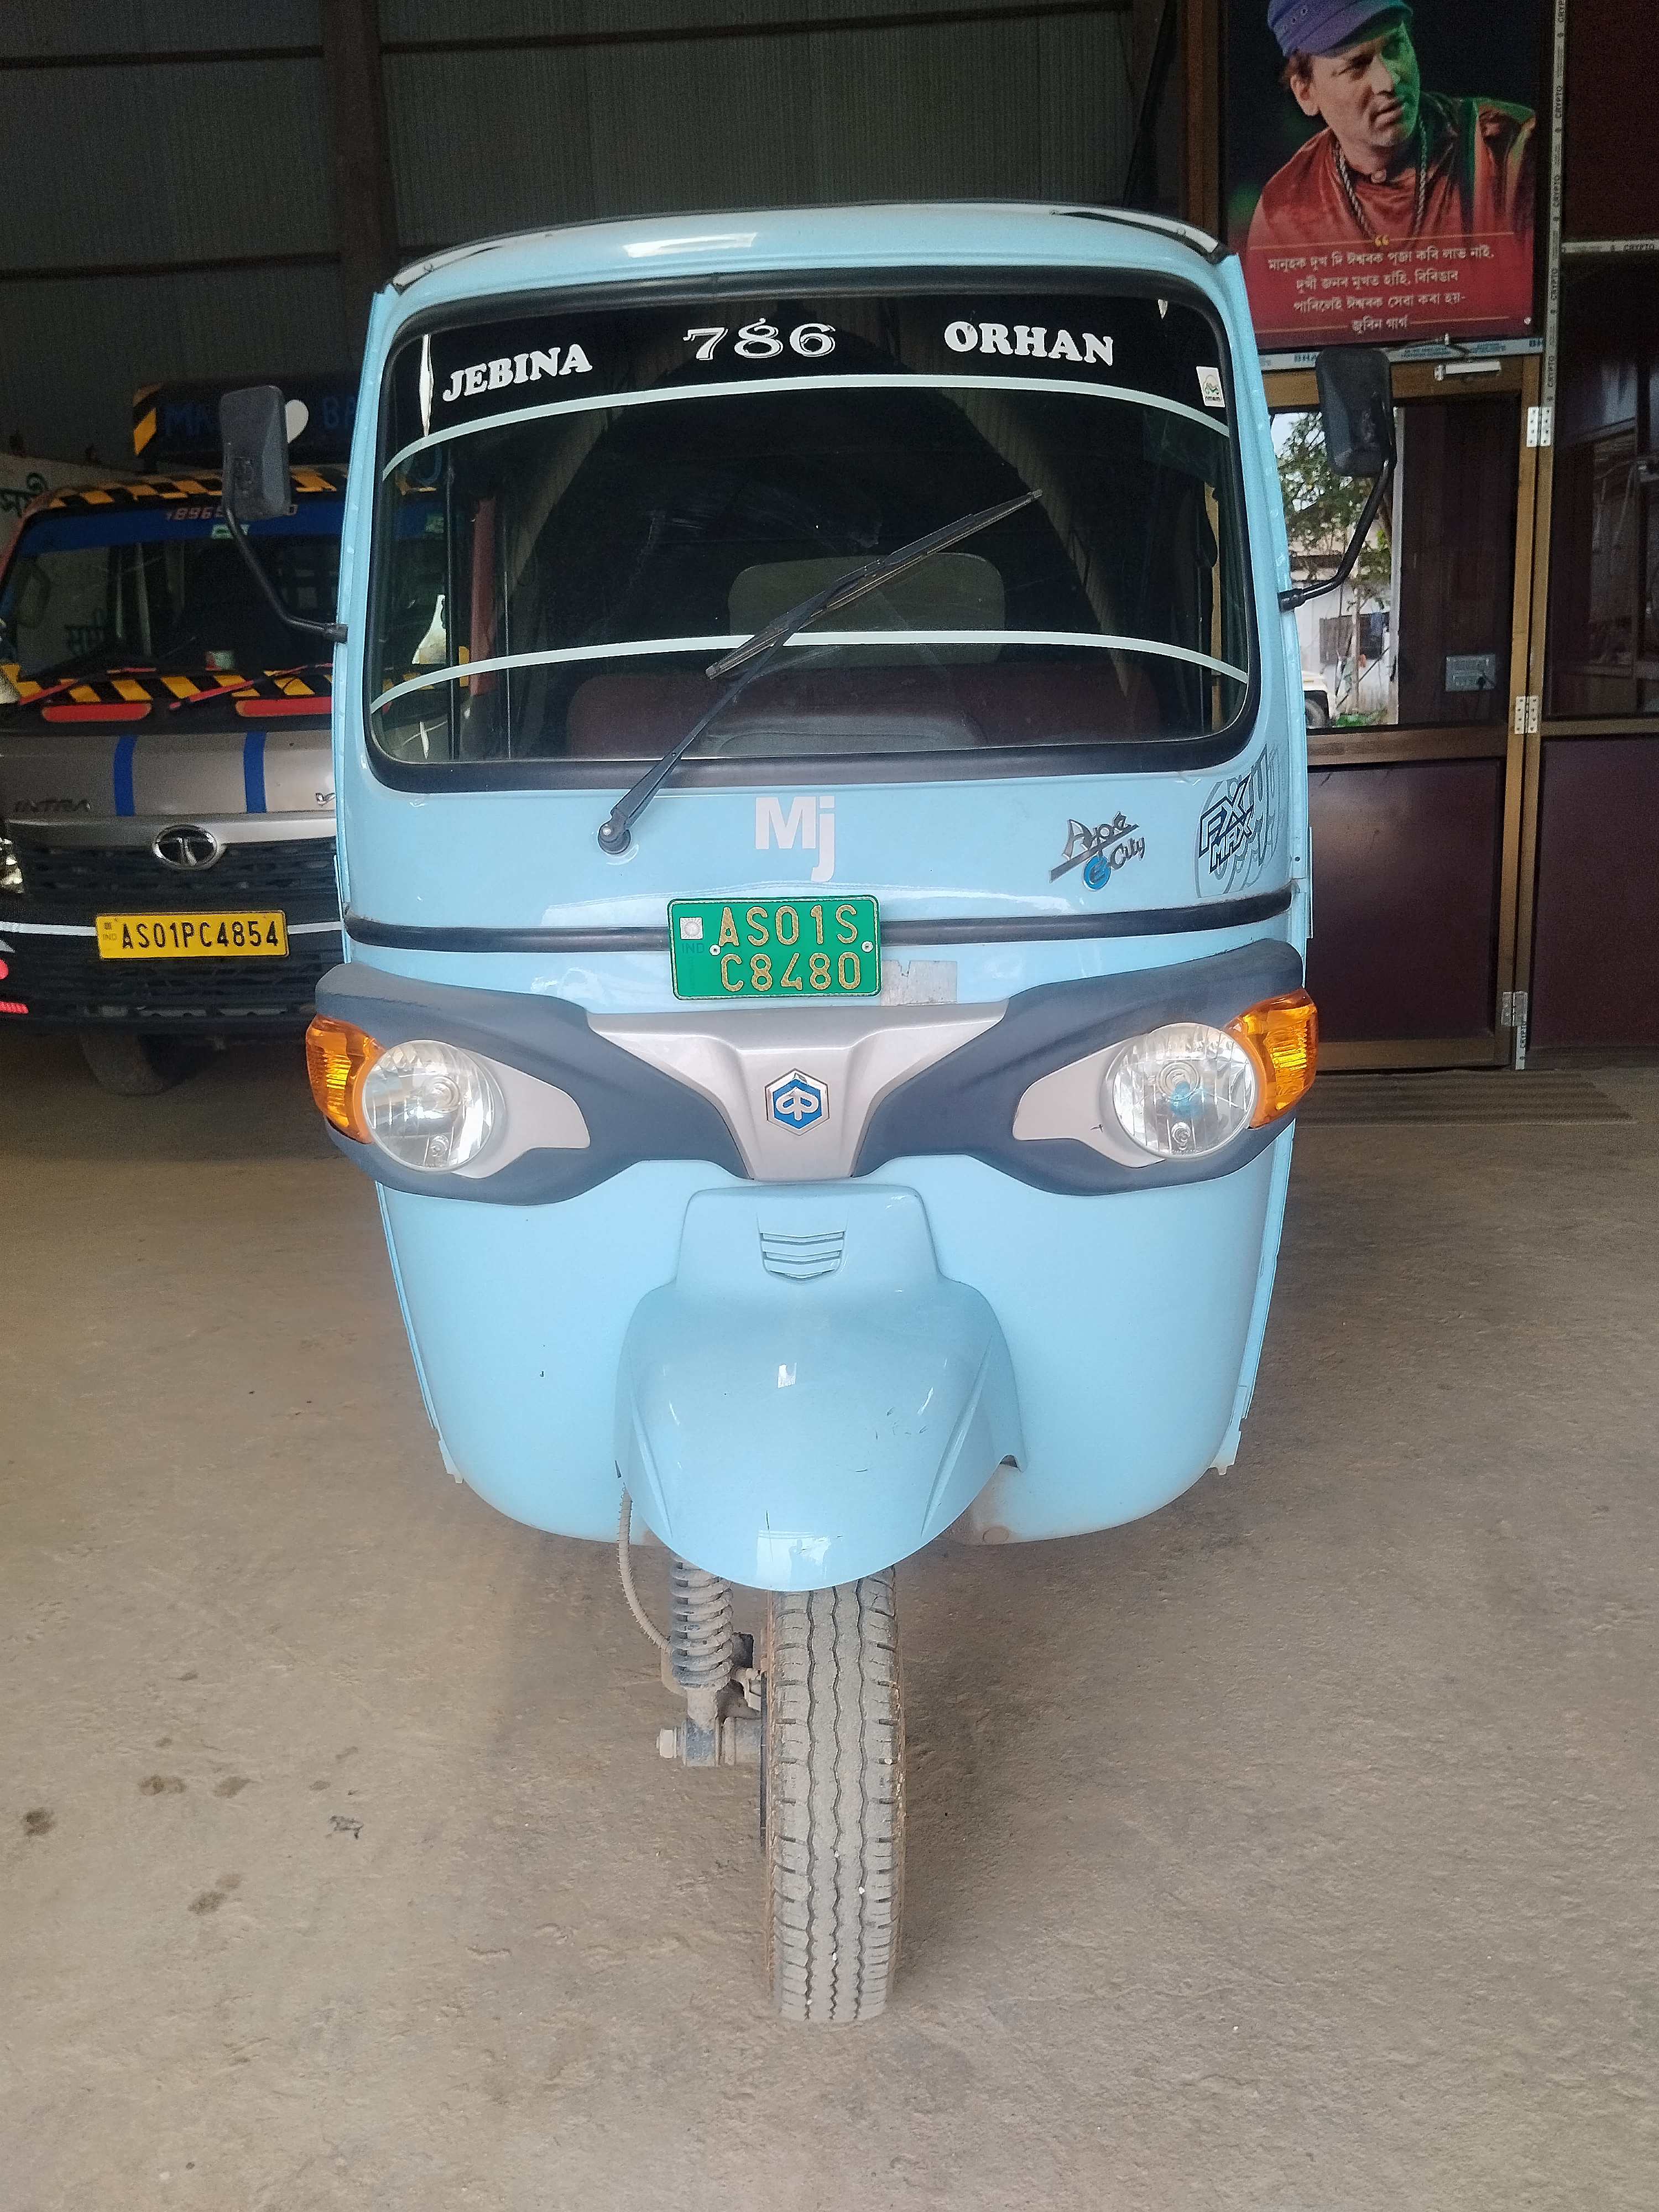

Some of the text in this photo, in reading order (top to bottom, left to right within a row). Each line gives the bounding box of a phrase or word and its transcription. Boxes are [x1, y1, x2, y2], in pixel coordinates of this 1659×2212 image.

[442, 318, 1113, 401] JEBINA 786 ORHAN
[755, 795, 836, 882] Mj
[1109, 837, 1145, 870] City
[1209, 803, 1254, 874] MAX
[122, 920, 278, 949] AS01PC4854
[718, 904, 858, 947] AS01S
[682, 942, 705, 954] IND
[721, 952, 862, 993] C8480
